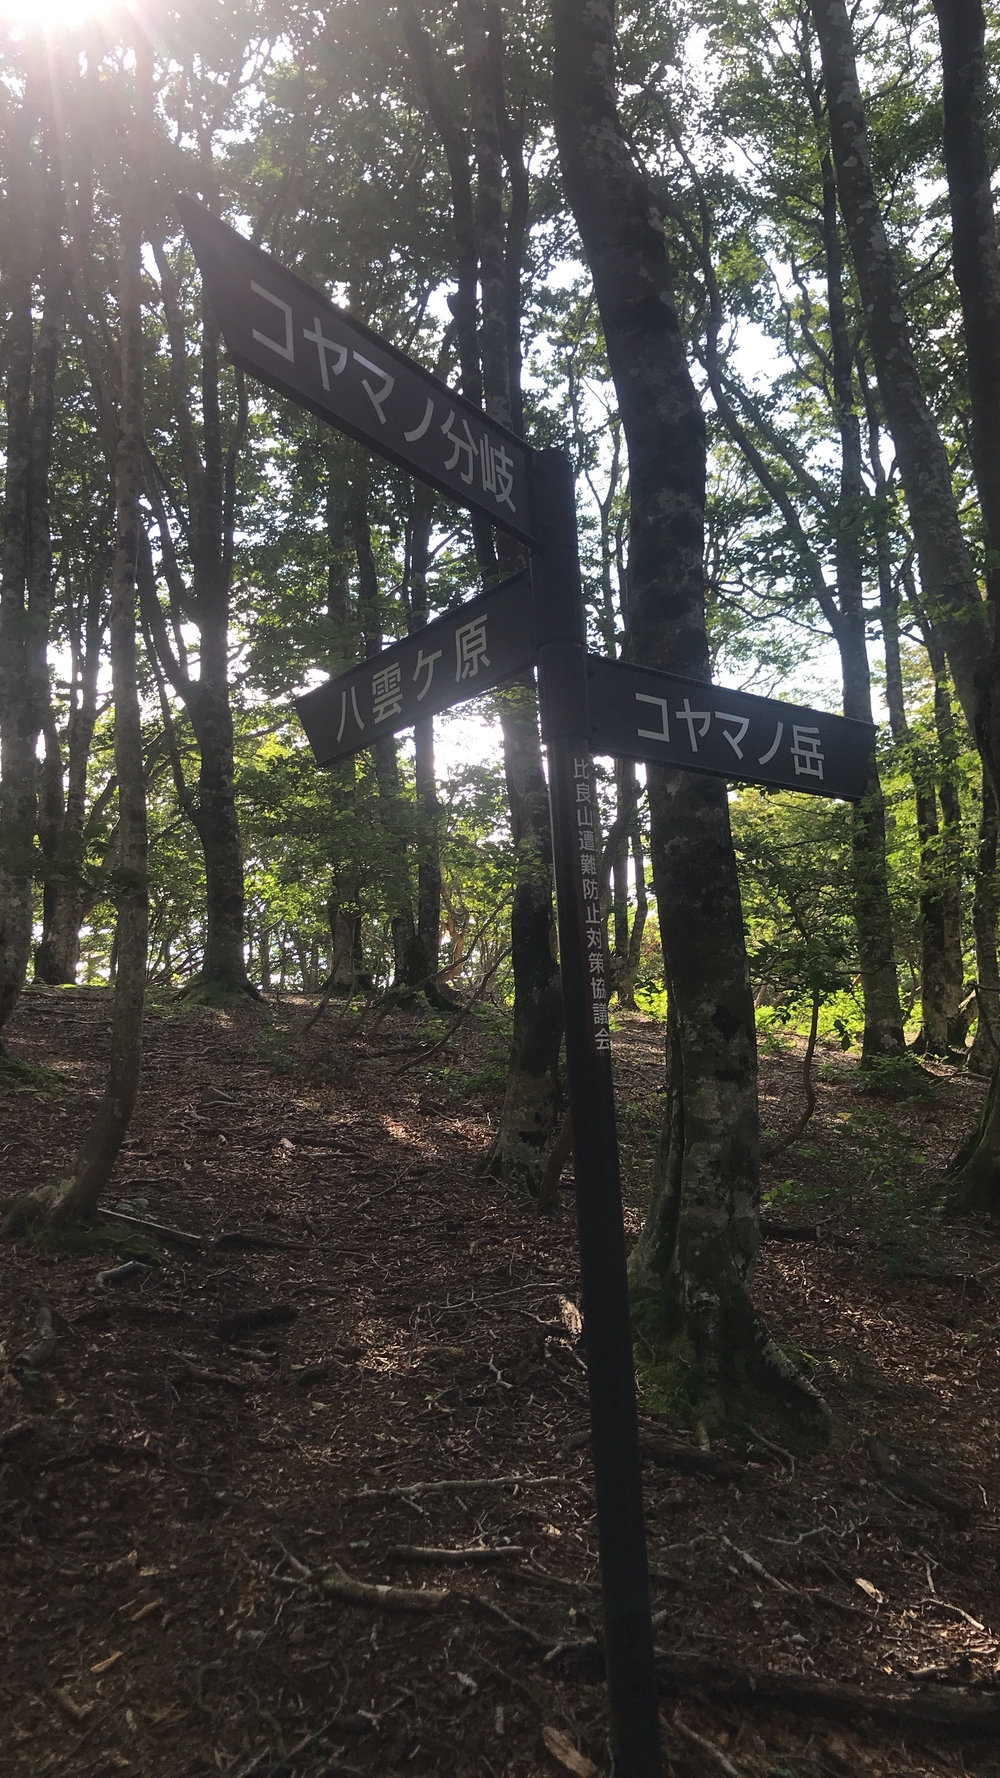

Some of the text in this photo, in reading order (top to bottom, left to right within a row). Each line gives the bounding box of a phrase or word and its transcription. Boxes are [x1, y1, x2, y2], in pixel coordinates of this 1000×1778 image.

[250, 280, 517, 513] コヤマノ分岐
[635, 692, 825, 780] コヤマノ岳
[573, 757, 610, 1050] 比良山遭難防止対策協議会
